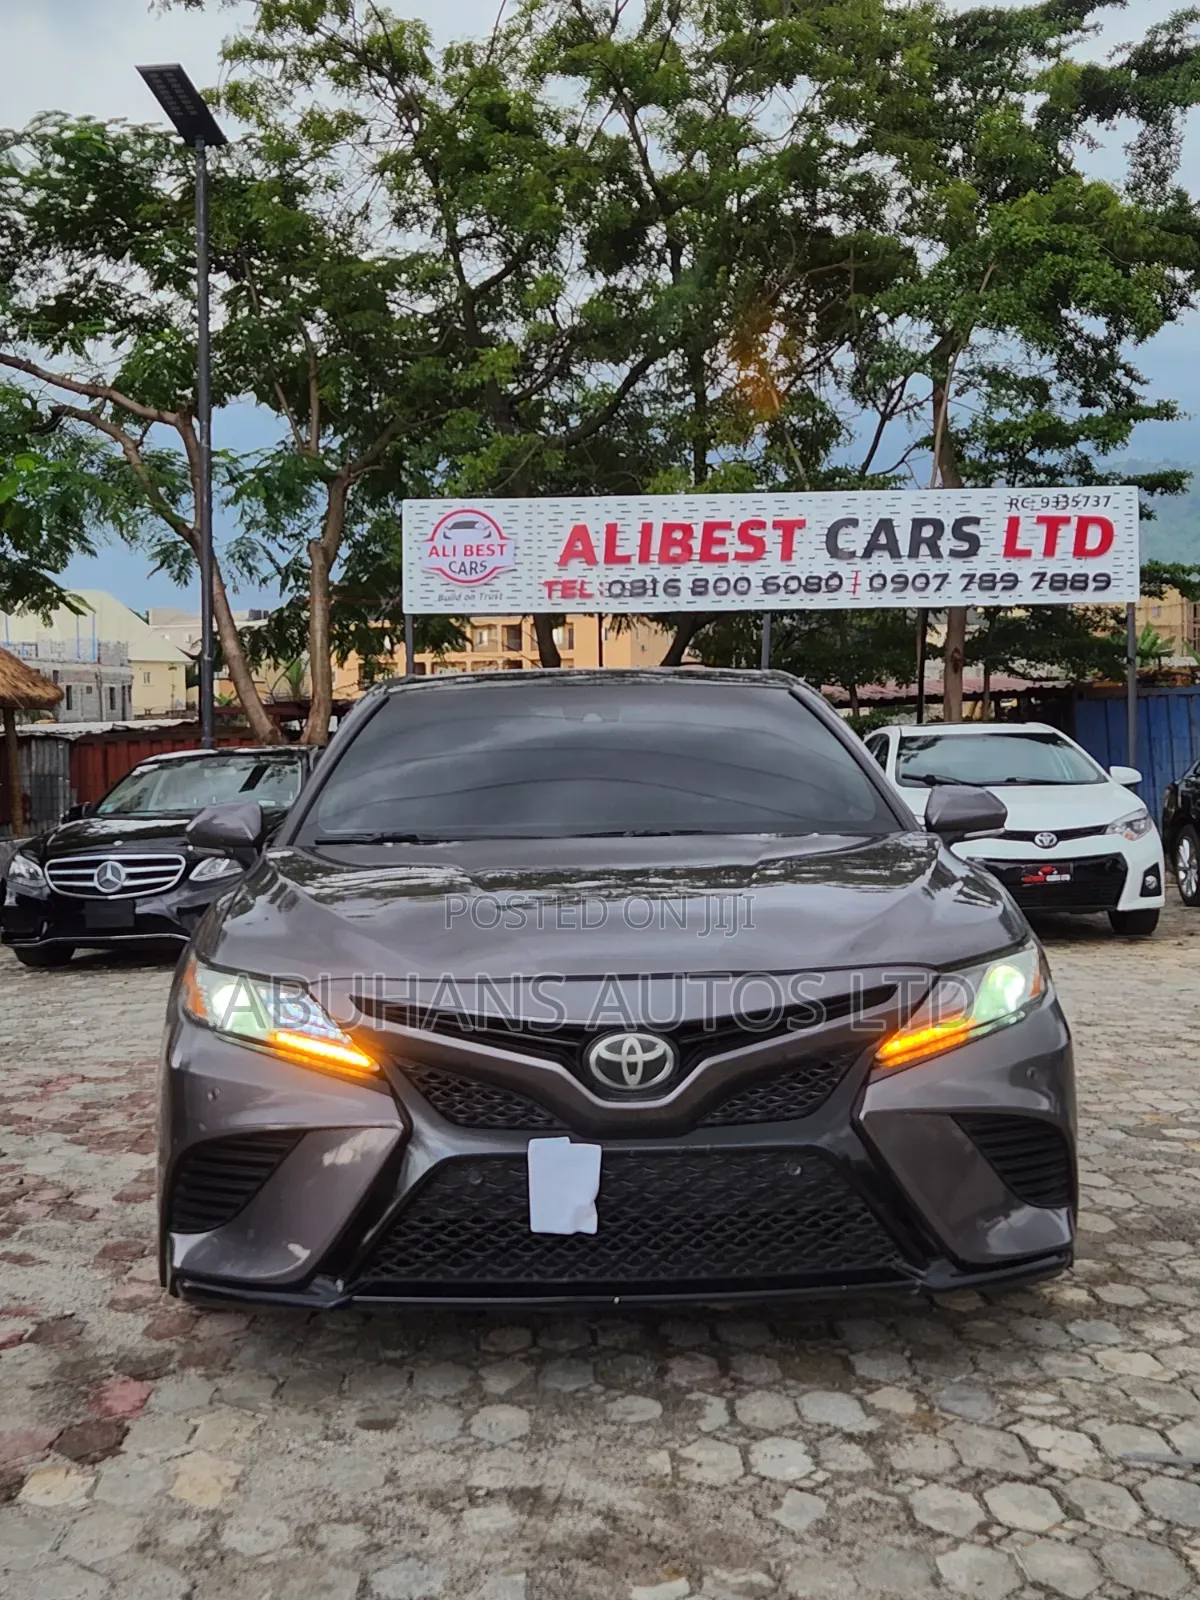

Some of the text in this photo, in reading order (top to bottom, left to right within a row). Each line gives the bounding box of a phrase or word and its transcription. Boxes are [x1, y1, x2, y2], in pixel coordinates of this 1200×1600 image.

[428, 543, 508, 558] ALI BEST
[556, 514, 1115, 567] ALIBEST CARS LTD
[448, 560, 489, 576] CARS
[607, 577, 681, 598] 0816
[690, 576, 752, 597] 800
[761, 572, 844, 594] 6080
[869, 571, 950, 593] 0907
[960, 572, 1021, 592] 789
[1031, 570, 1113, 592] 7889
